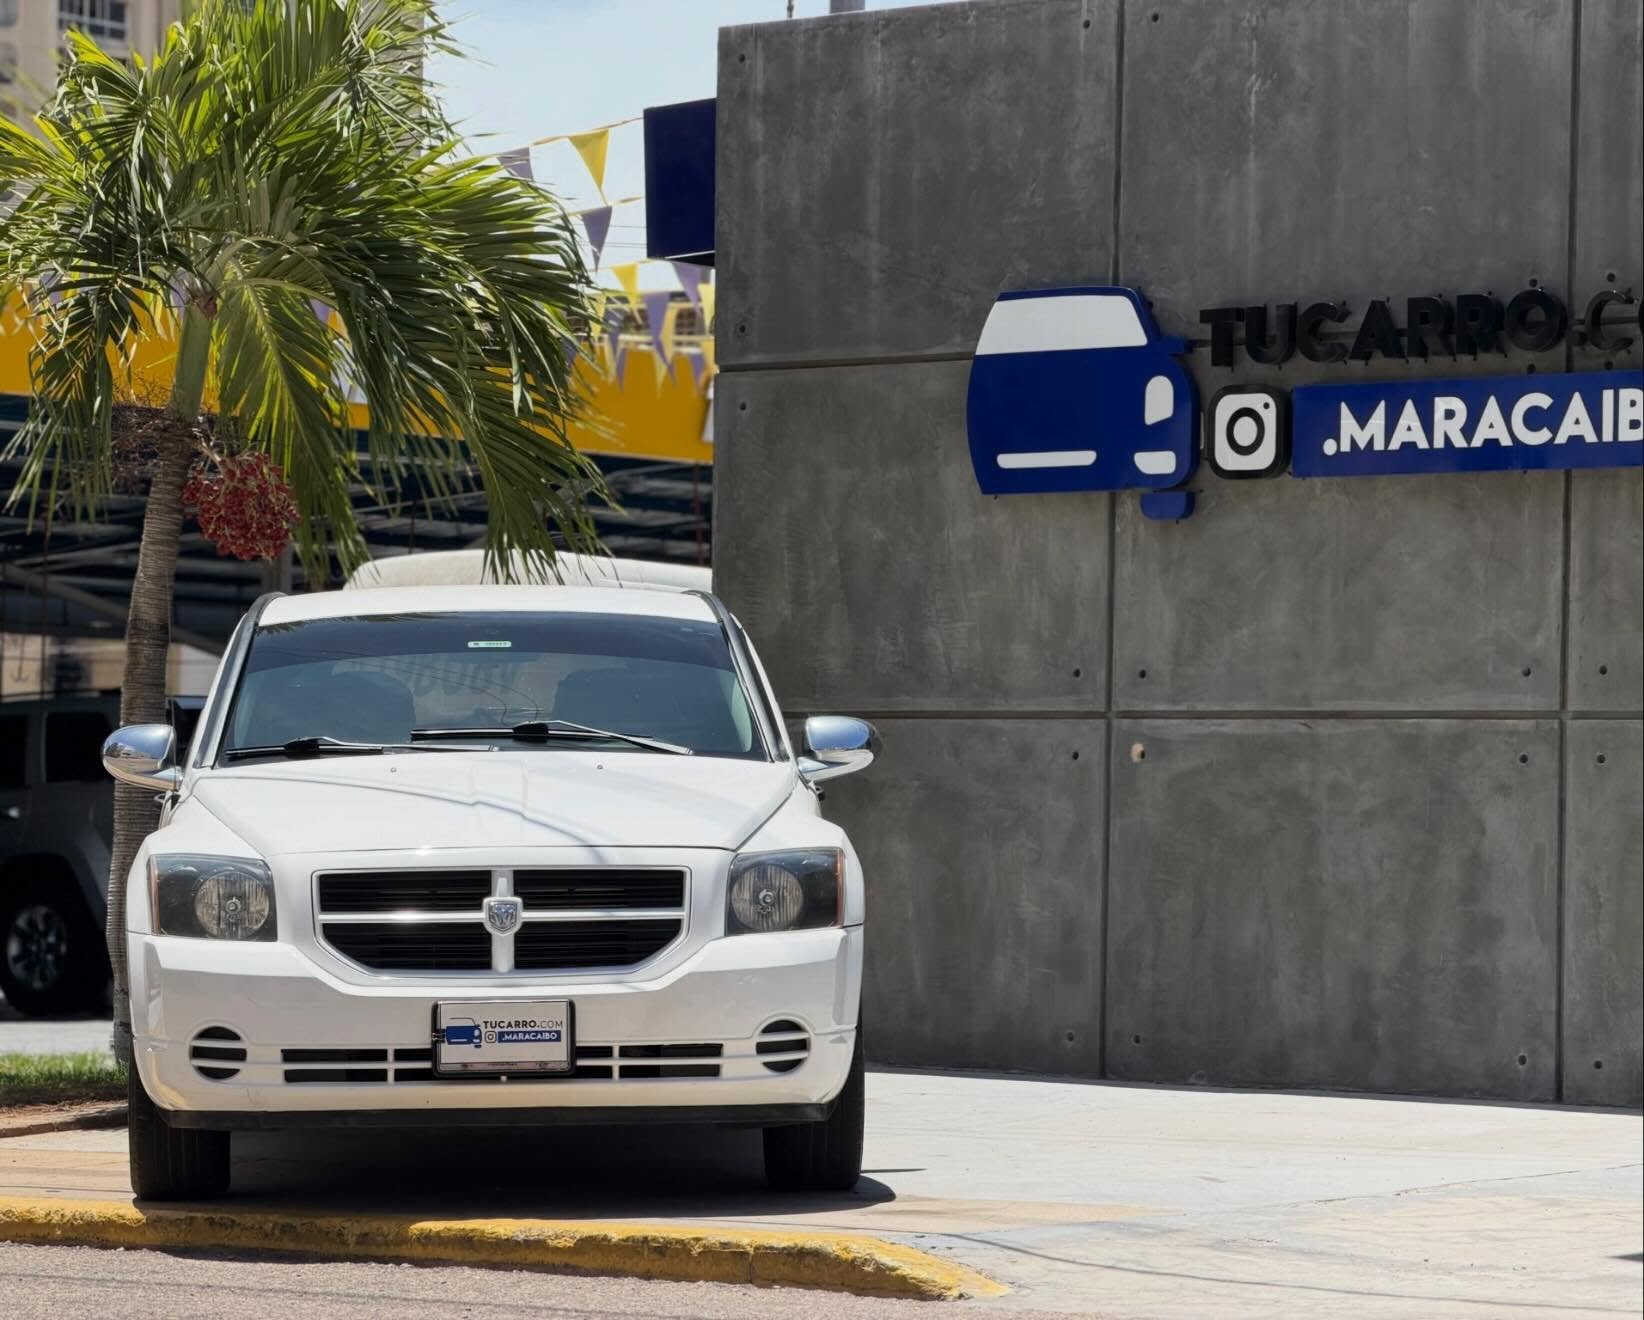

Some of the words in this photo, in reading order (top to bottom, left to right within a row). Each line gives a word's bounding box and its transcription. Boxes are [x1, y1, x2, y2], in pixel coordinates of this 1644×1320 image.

[1200, 288, 1643, 367] TUCARRO.C
[483, 1020, 563, 1029] TUCARRO.COM
[502, 1032, 557, 1041] .MARACAIBO
